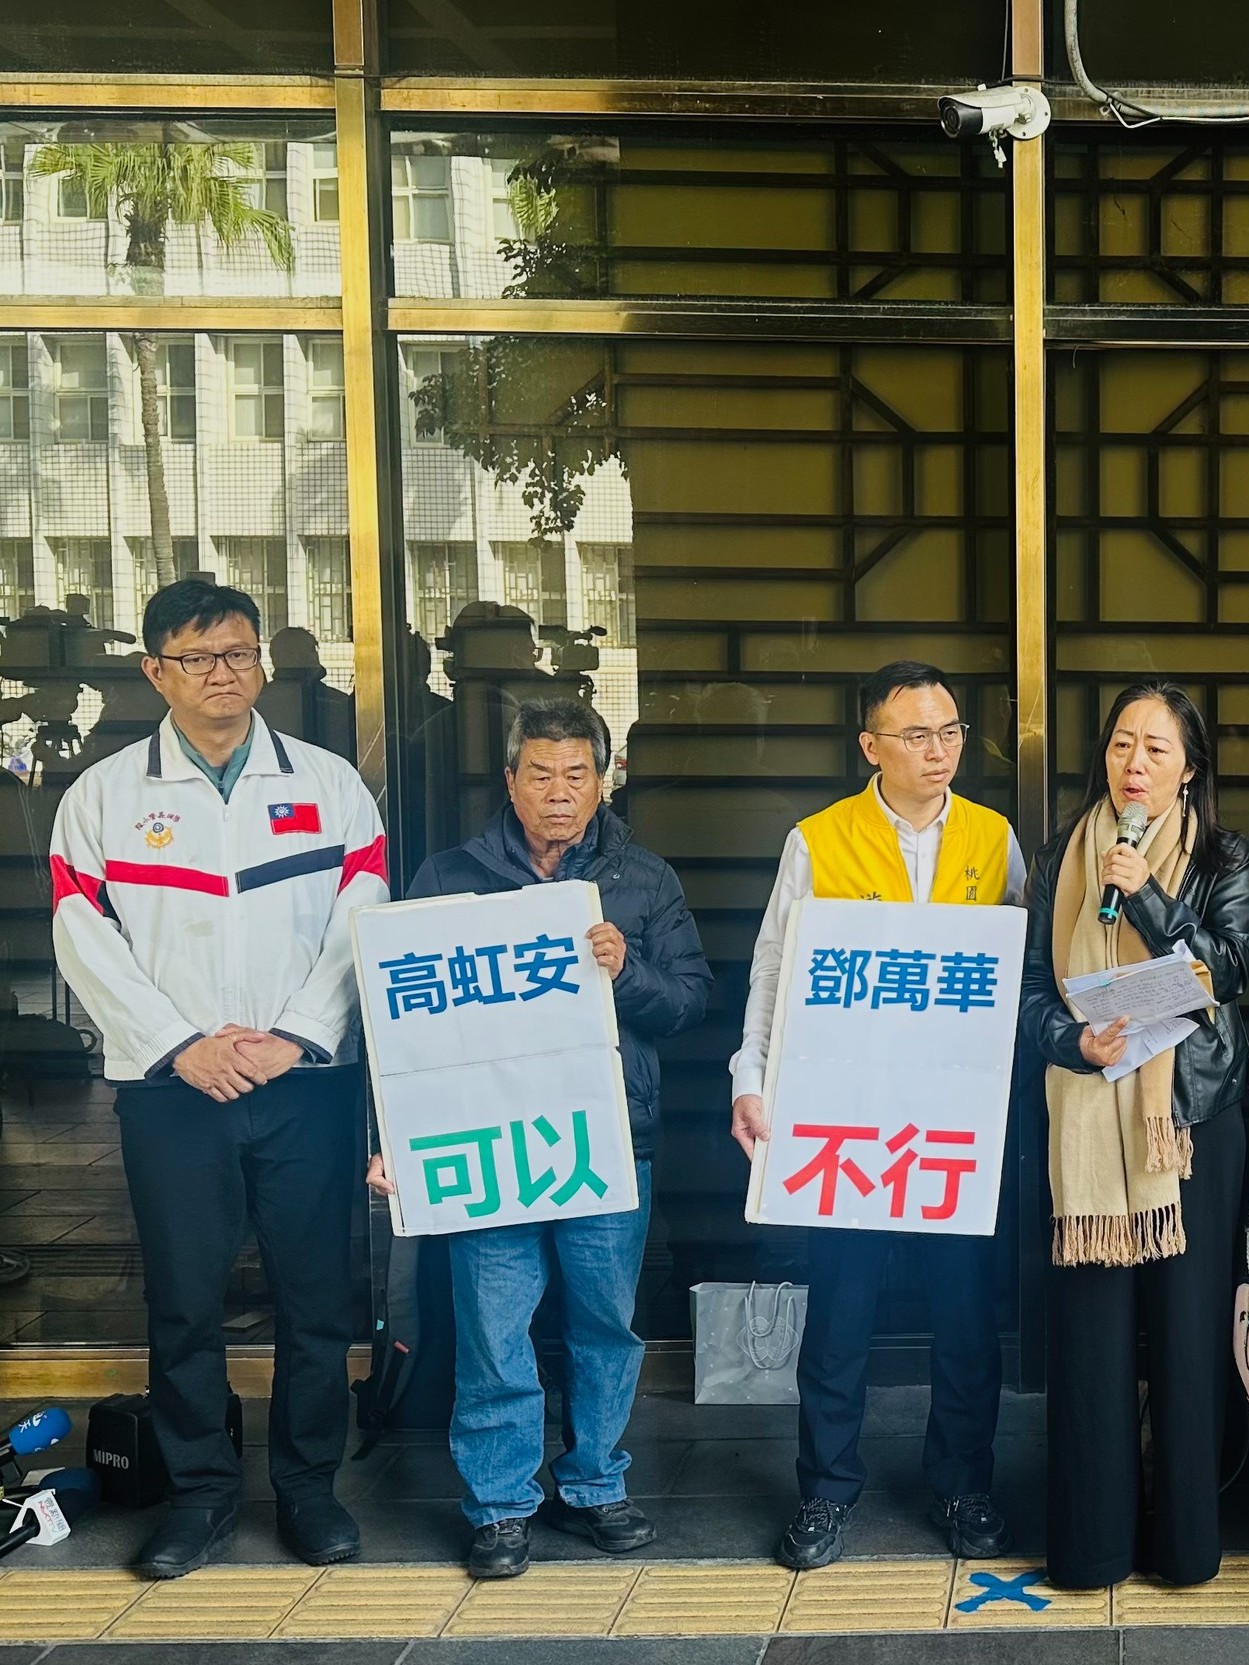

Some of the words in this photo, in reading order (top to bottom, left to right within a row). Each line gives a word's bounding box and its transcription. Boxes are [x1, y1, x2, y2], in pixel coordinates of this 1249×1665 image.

[965, 866, 980, 902] 桃園
[379, 934, 581, 1020] 高虹安
[805, 947, 999, 1013] 鄧萬華
[409, 1109, 609, 1219] 可以
[782, 1122, 977, 1220] 不行
[93, 1448, 130, 1470] MIPRO
